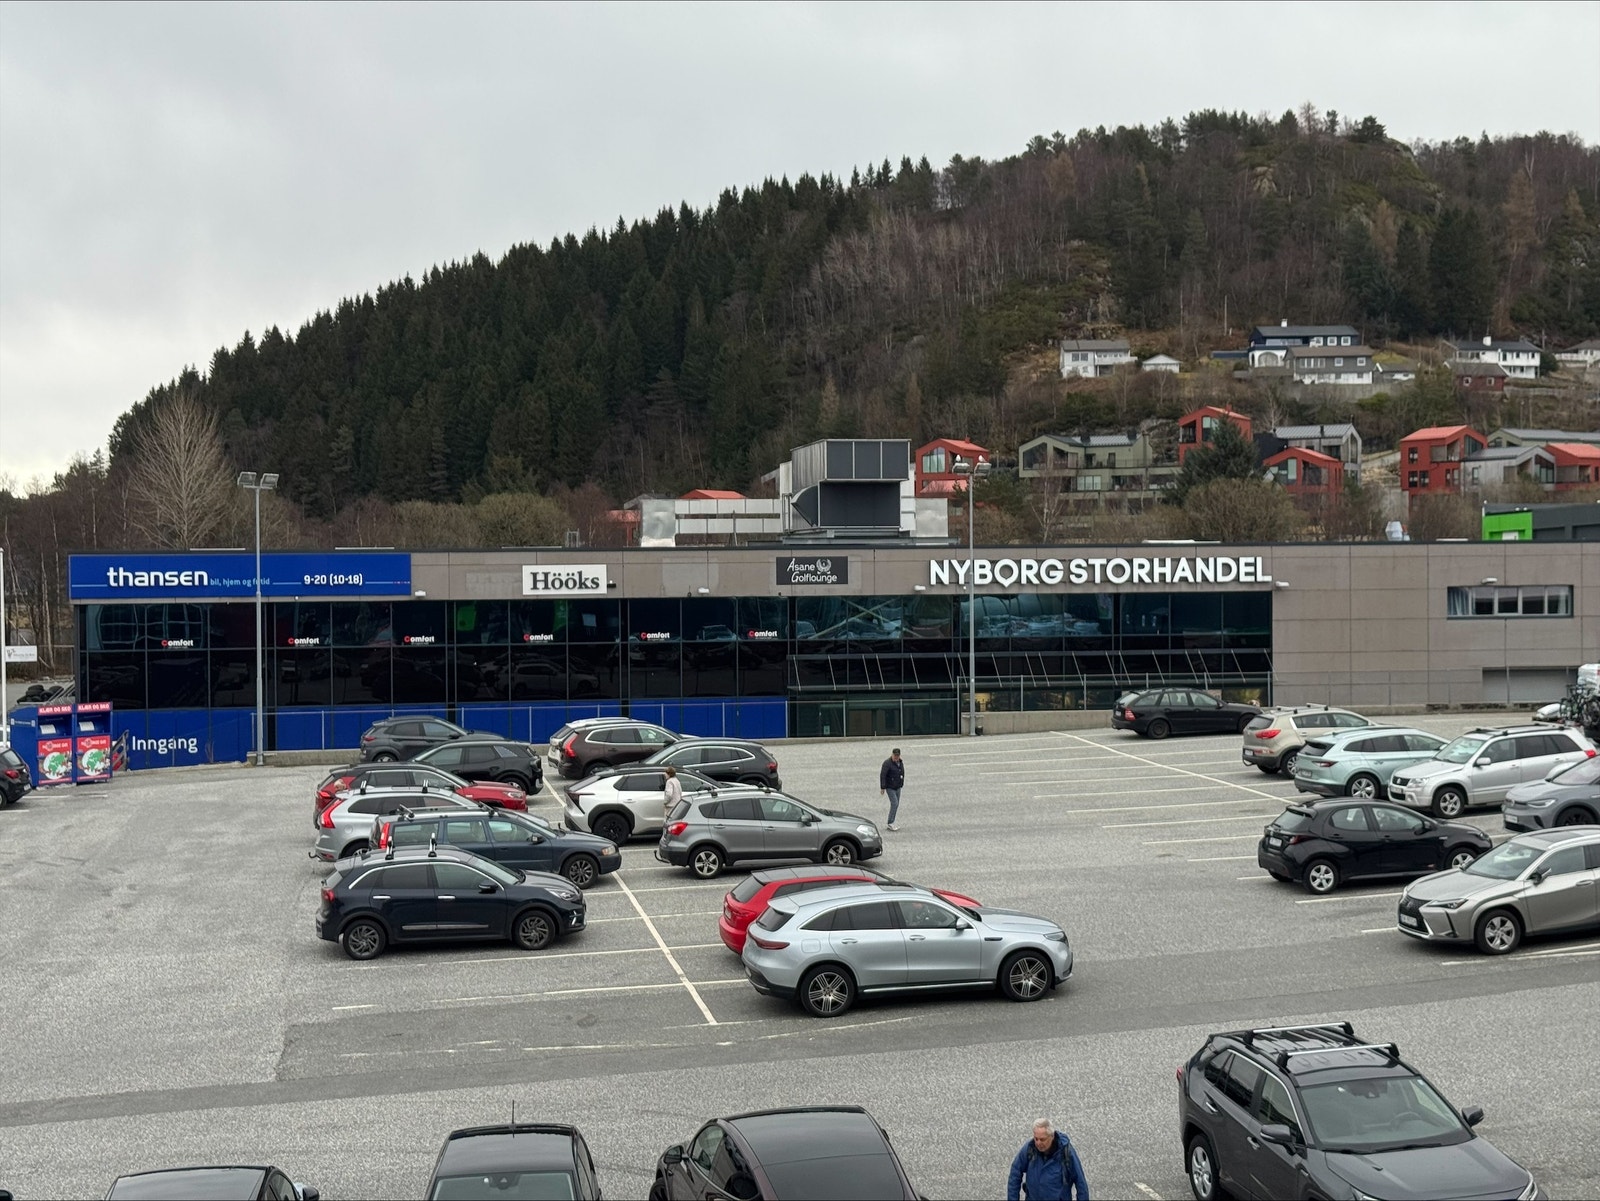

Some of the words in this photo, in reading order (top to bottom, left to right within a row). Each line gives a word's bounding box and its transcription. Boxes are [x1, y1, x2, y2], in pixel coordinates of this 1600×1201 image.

[106, 566, 208, 587] thansen
[223, 578, 241, 588] hjem
[242, 579, 252, 588] og
[252, 577, 270, 586] ftid
[303, 575, 327, 585] 9-20
[329, 574, 363, 586] (10-18)
[530, 570, 600, 590] Hööks
[791, 571, 838, 584] Golflounge
[929, 558, 1065, 588] NYBORG
[1069, 557, 1273, 585] STORHANDEL
[132, 735, 198, 755] Inngang
